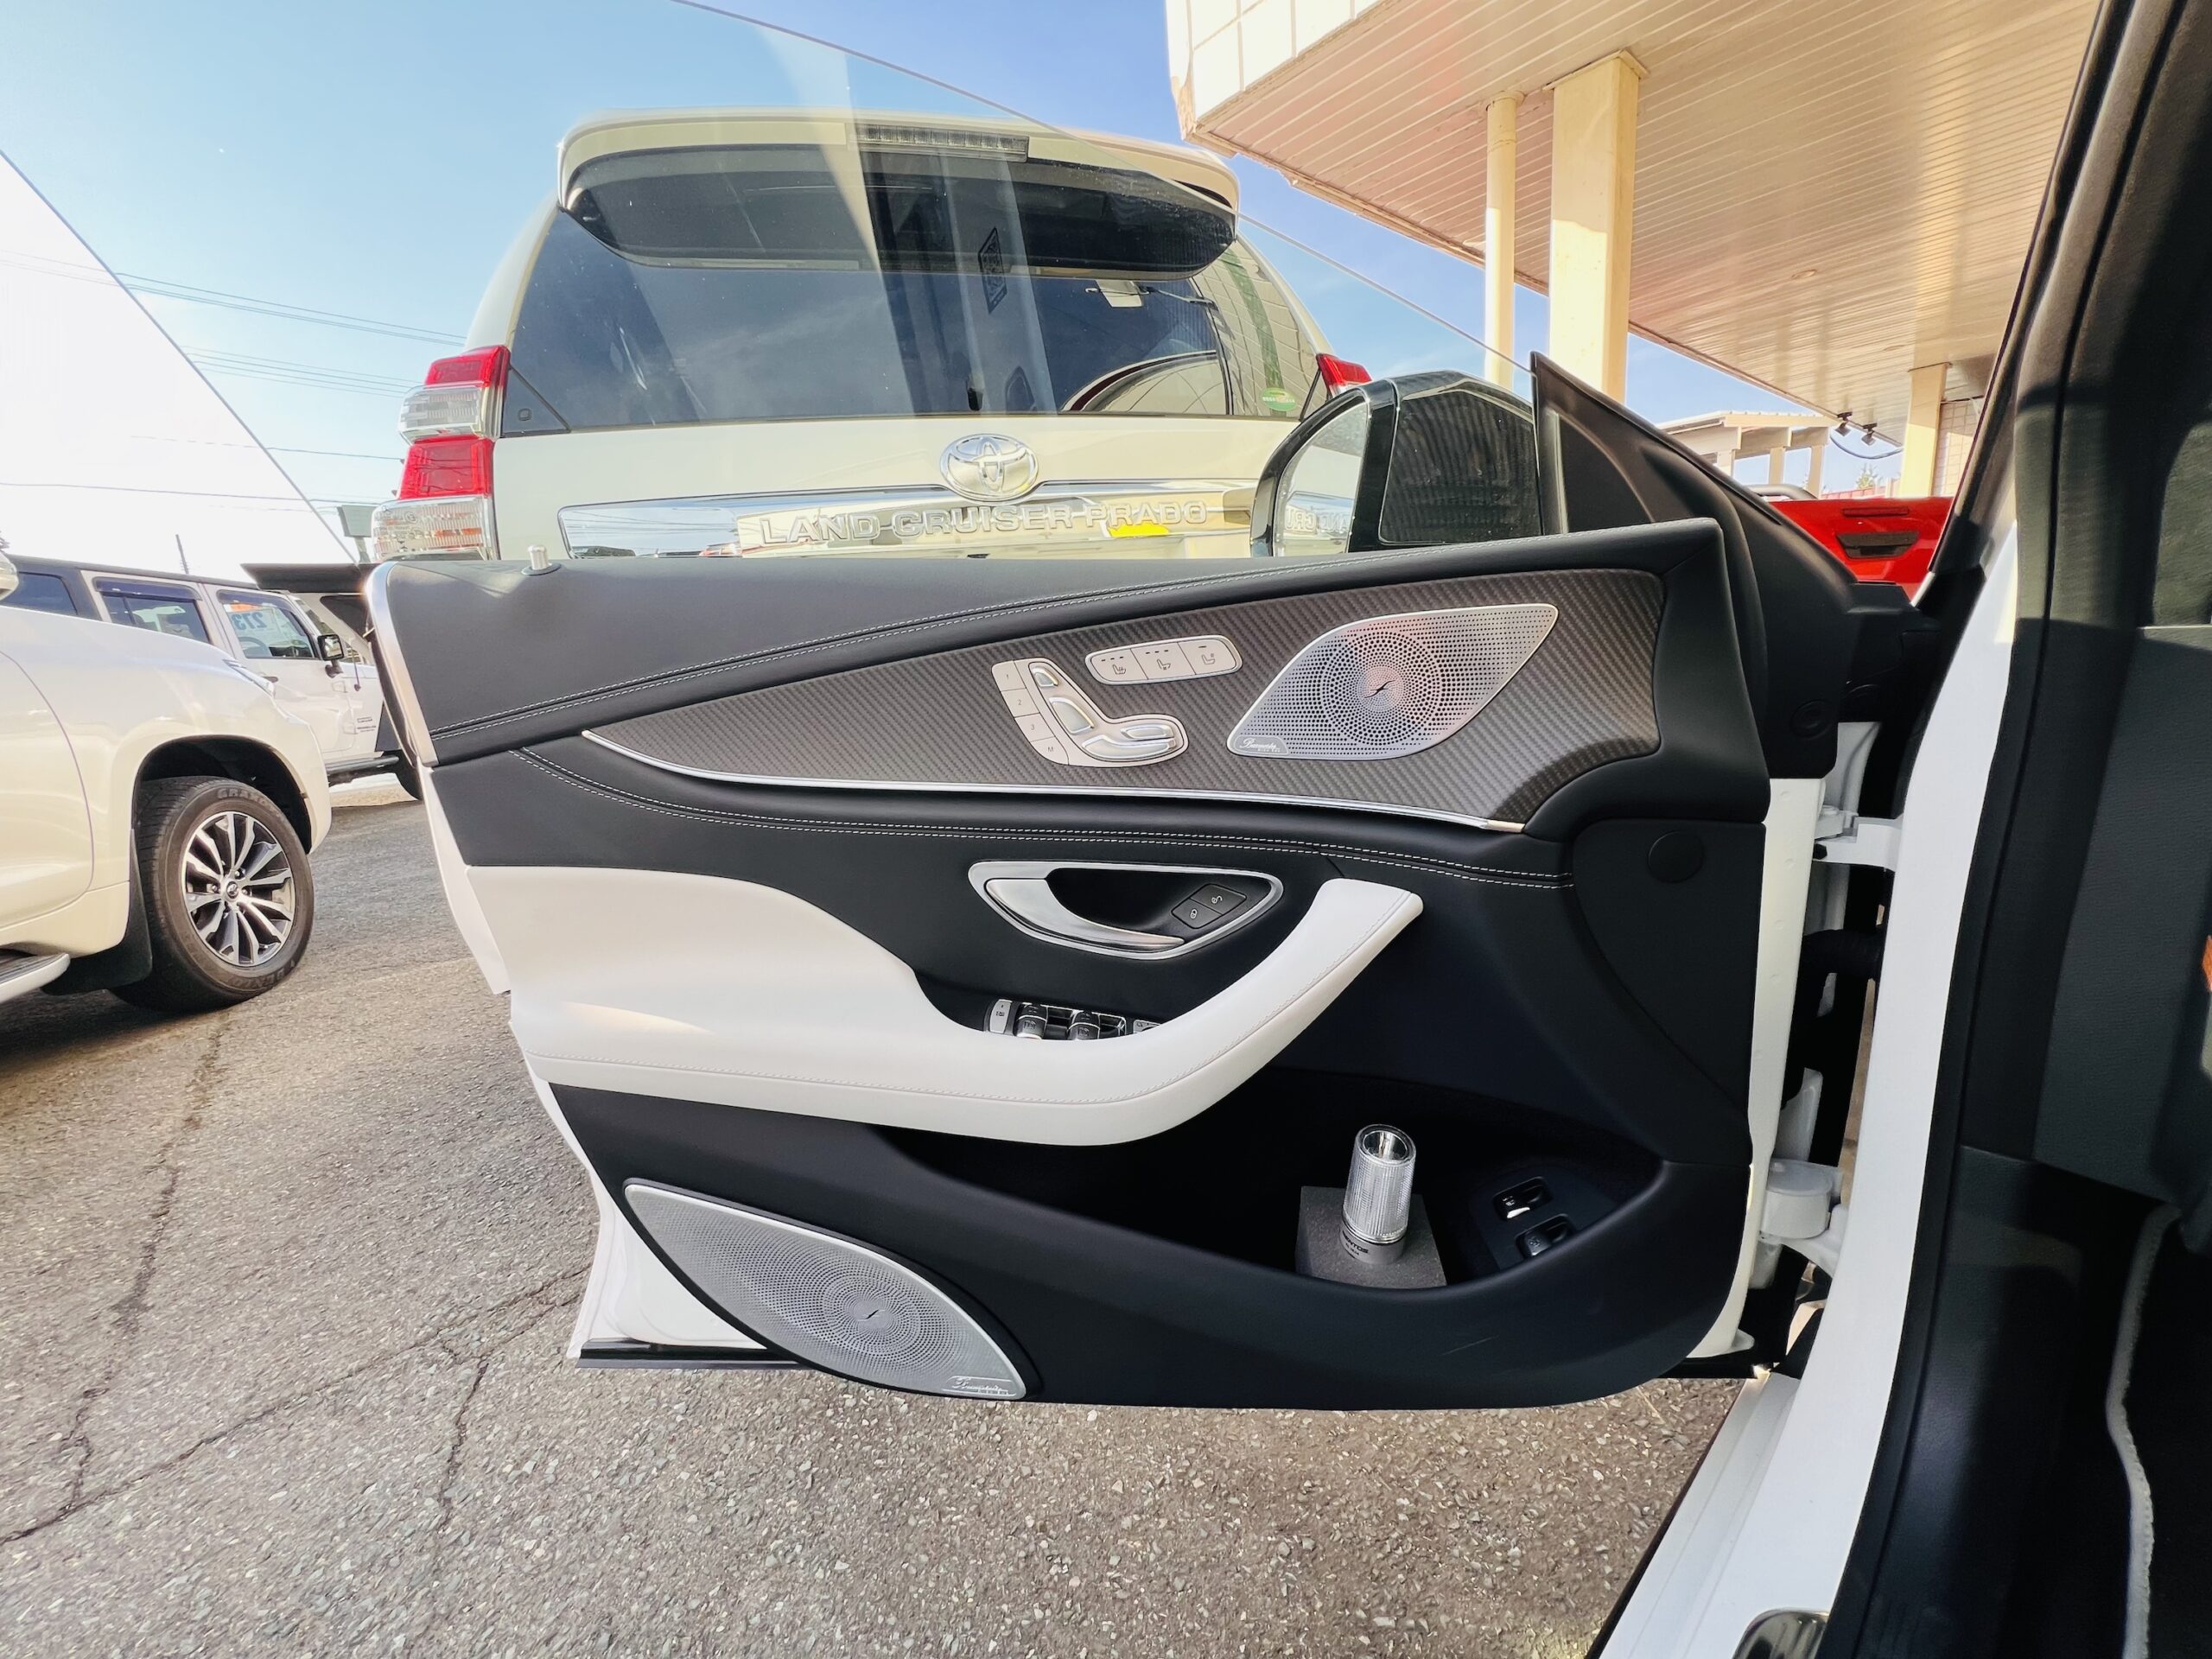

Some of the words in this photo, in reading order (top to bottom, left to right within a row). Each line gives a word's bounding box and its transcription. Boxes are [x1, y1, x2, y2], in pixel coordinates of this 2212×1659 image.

[760, 513, 880, 544] LAND
[892, 503, 1073, 537] CRUISER
[1083, 500, 1208, 528] PRADO
